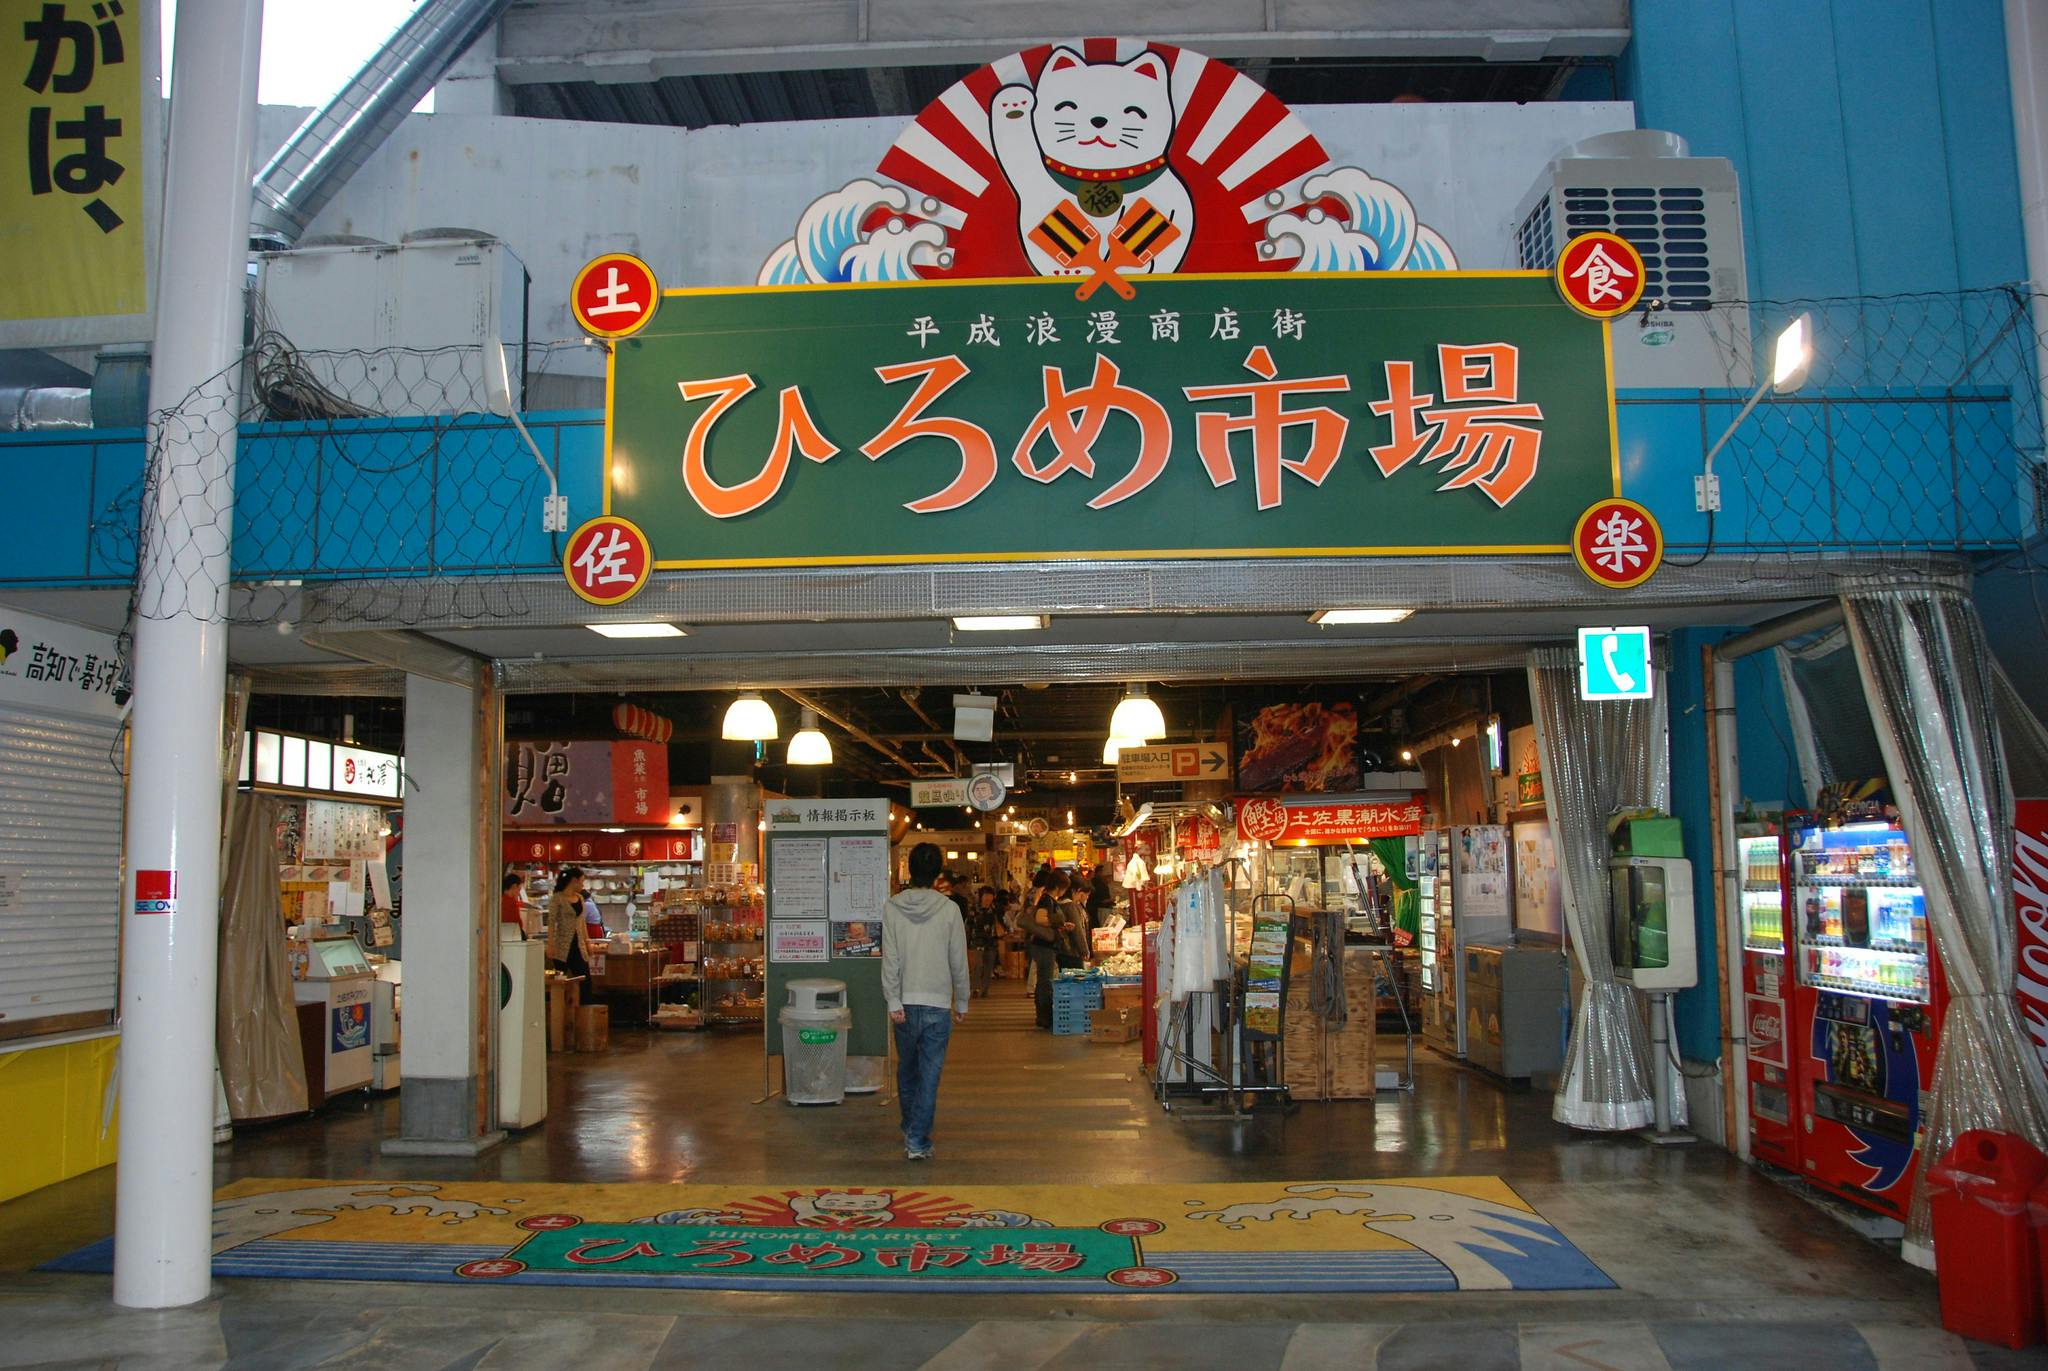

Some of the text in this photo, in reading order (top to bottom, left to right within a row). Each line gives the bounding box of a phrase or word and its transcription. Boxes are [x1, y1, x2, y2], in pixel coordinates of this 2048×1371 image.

[23, 0, 126, 235] がは、
[1084, 181, 1120, 213] 福
[586, 266, 642, 318] 土
[1569, 242, 1635, 304] 食
[906, 307, 1307, 349] 平成浪漫商店街
[676, 341, 1545, 520] ひろめ市場
[572, 527, 637, 589] 佐
[1589, 510, 1649, 574] 楽
[806, 808, 876, 822] 情報掲示板
[1289, 805, 1422, 827] 土佐黒潮水産
[530, 1216, 567, 1227] 土
[470, 1261, 511, 1274] 佐
[564, 1238, 1083, 1272] ひろめ市場
